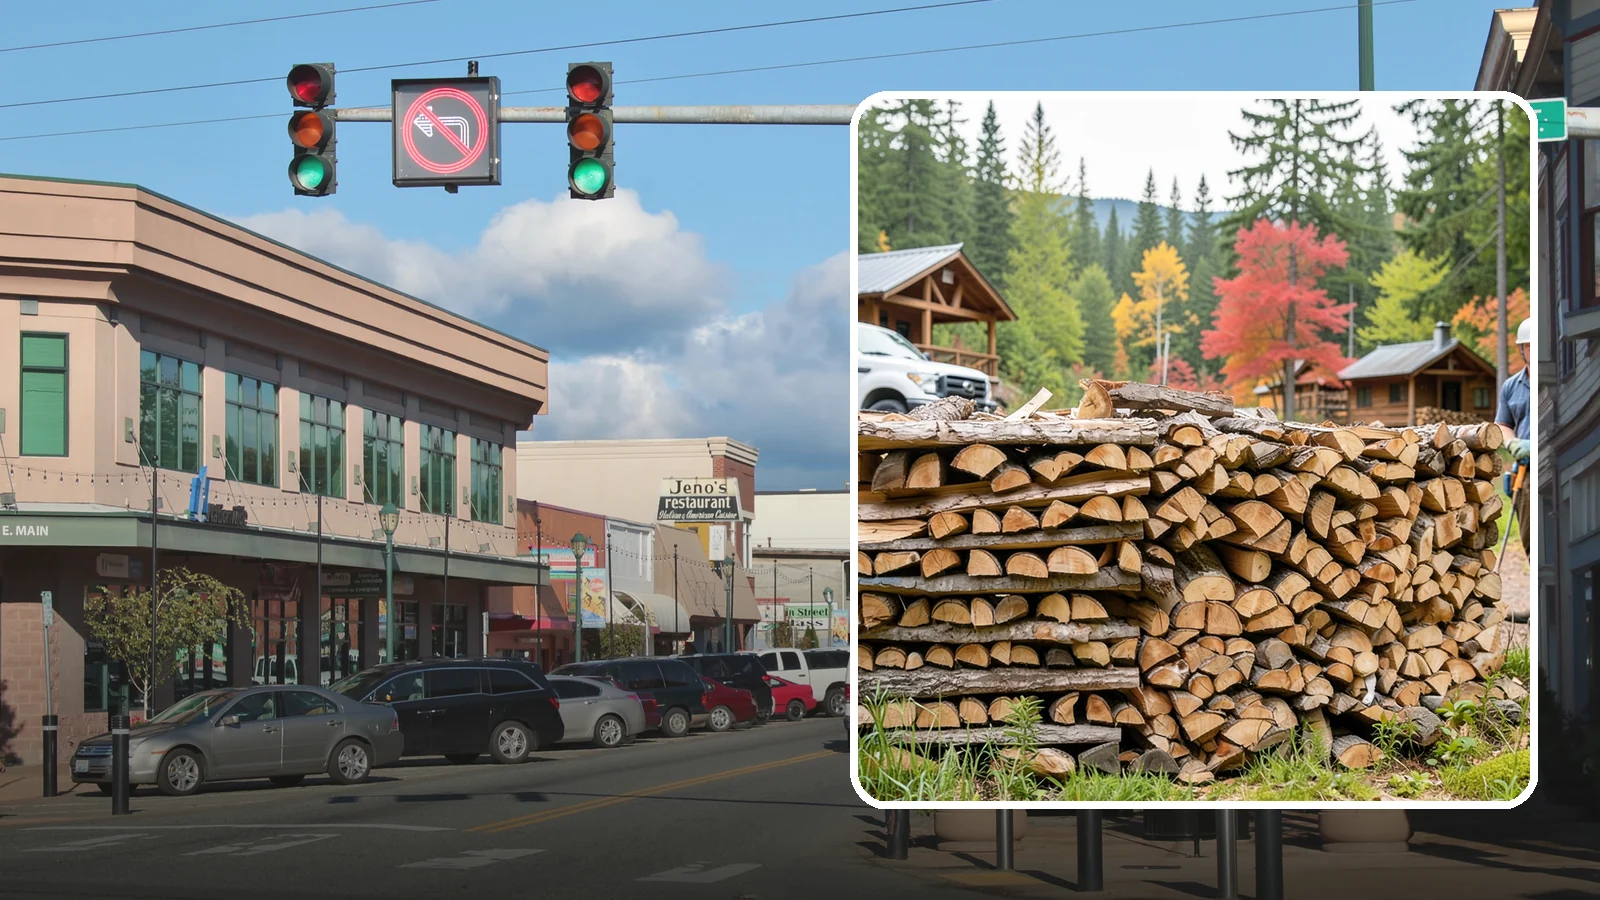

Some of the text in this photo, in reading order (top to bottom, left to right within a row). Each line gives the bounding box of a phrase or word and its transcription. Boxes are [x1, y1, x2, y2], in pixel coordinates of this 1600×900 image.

[669, 480, 727, 494] Jeno's
[665, 496, 731, 508] restaurant
[686, 510, 714, 519] American
[715, 510, 737, 519] Cuisine
[2, 525, 49, 536] E. MAIN
[797, 608, 828, 617] Street
